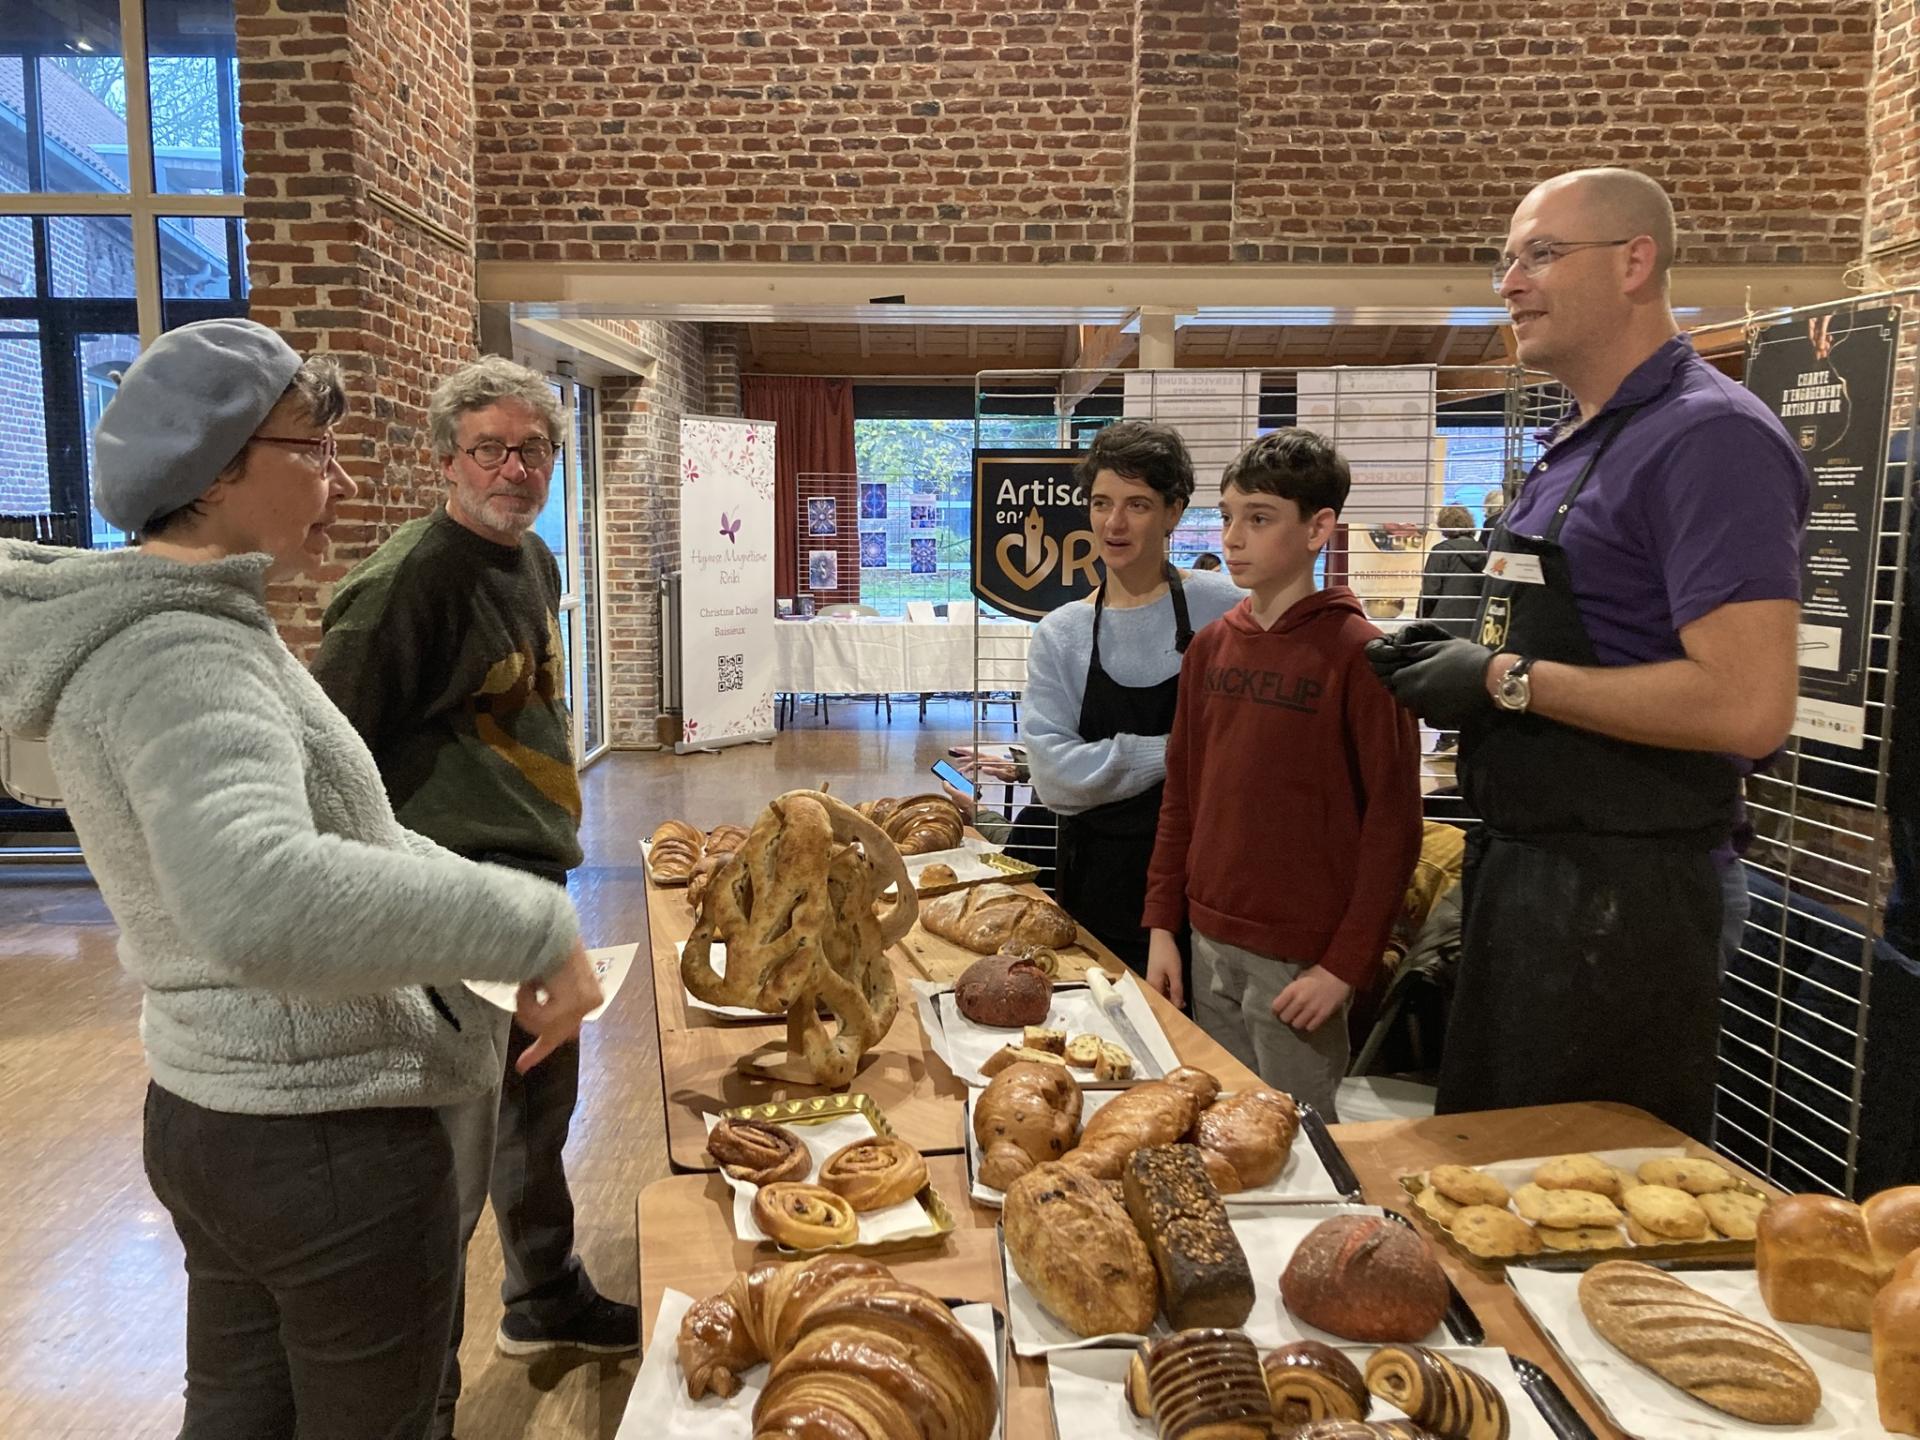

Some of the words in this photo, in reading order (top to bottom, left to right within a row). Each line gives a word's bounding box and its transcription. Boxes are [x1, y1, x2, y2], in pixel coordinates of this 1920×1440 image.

[1780, 401, 1816, 417] ARTISAN
[700, 608, 734, 617] Christine
[1204, 667, 1324, 705] KICKFLIP
